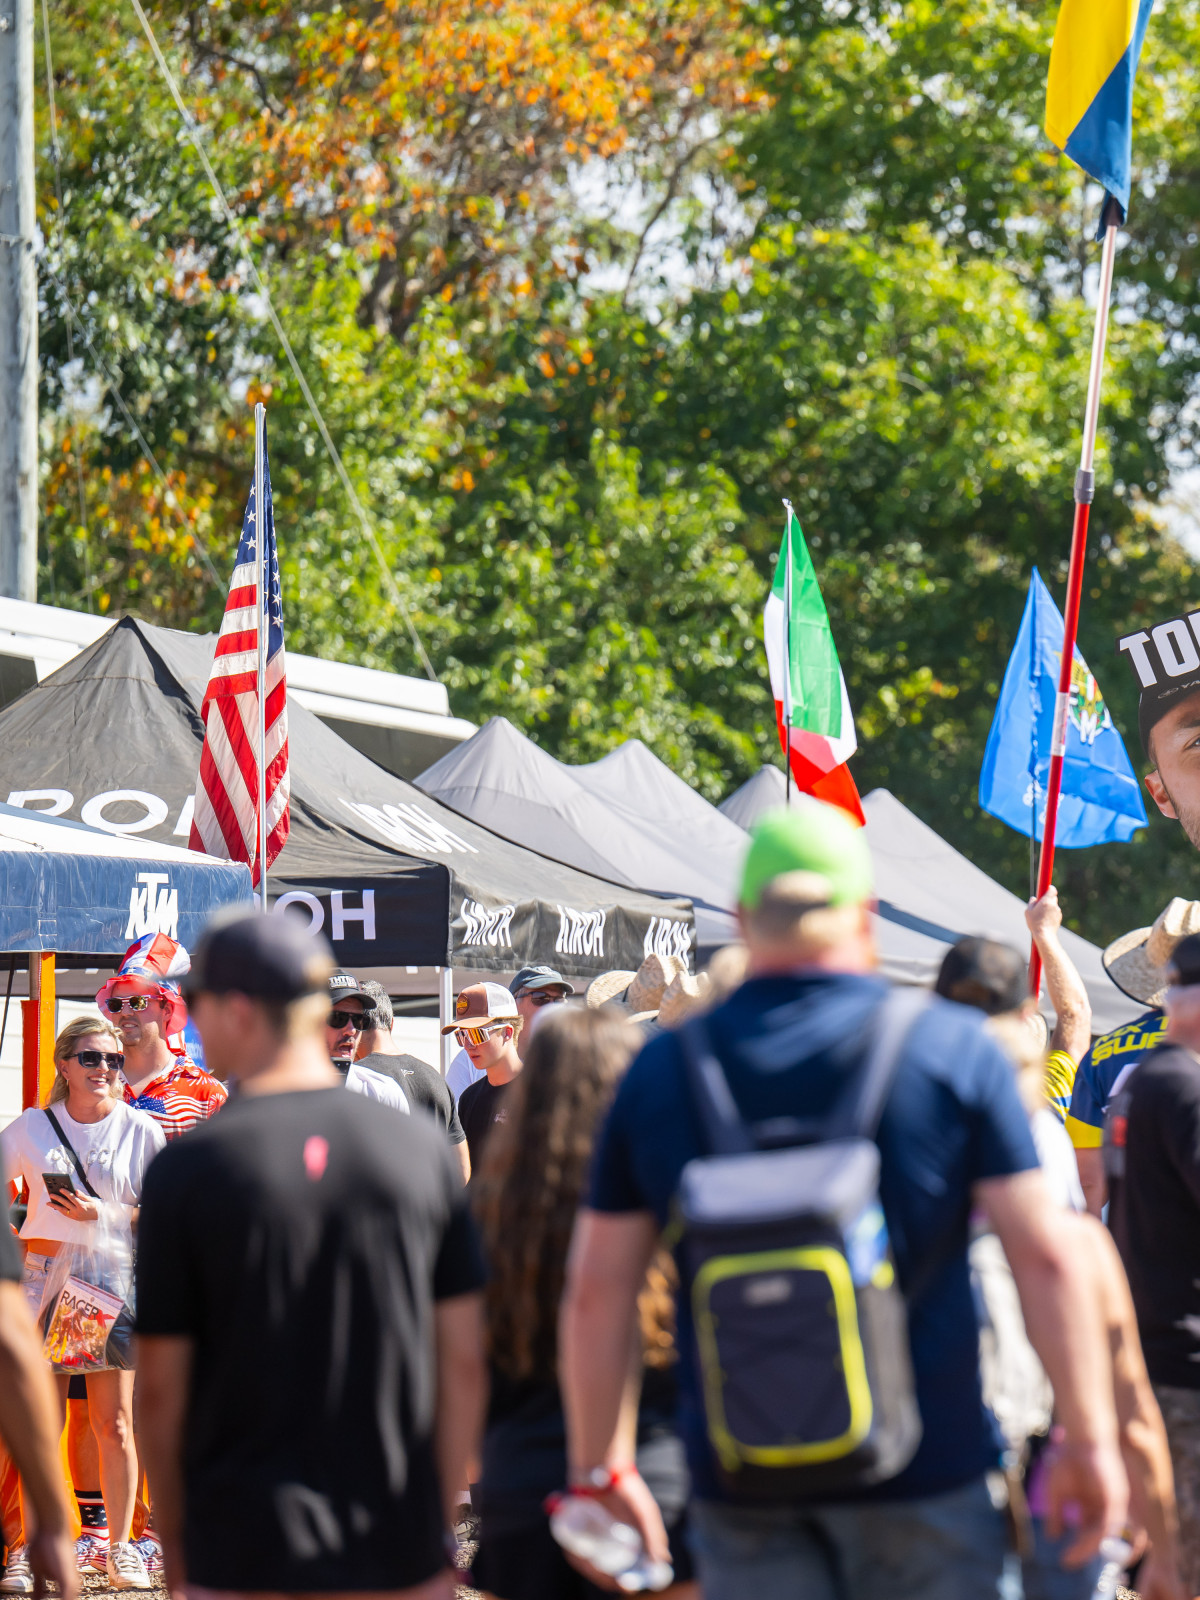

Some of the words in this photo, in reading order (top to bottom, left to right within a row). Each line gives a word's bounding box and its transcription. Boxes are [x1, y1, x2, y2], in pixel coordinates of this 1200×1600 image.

[125, 872, 178, 941] KTM
[460, 898, 516, 948] AIROH
[555, 904, 607, 957] AIROH
[60, 1290, 99, 1320] RACER
